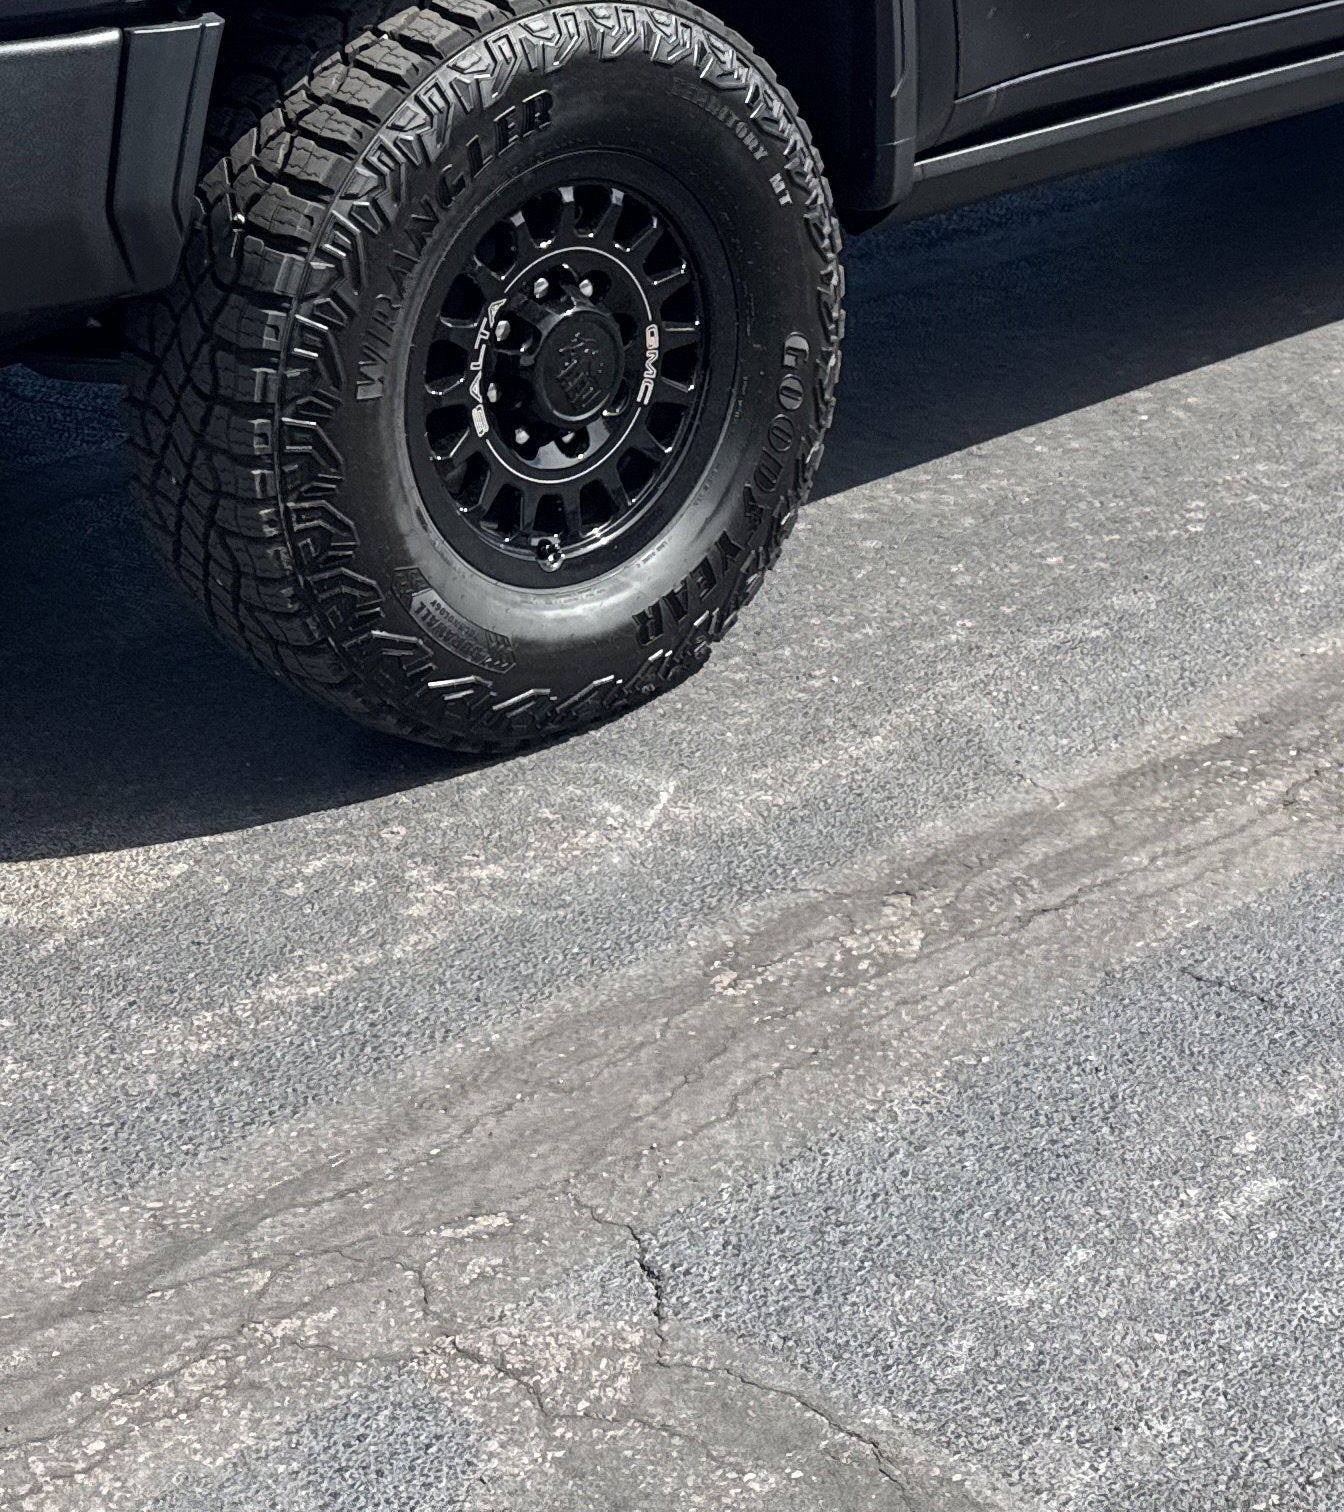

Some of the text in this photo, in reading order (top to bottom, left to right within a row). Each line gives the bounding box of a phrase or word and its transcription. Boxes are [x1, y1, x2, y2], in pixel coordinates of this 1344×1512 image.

[768, 172, 793, 207] MT
[355, 88, 554, 400] WRANGLER
[635, 323, 660, 406] GMC
